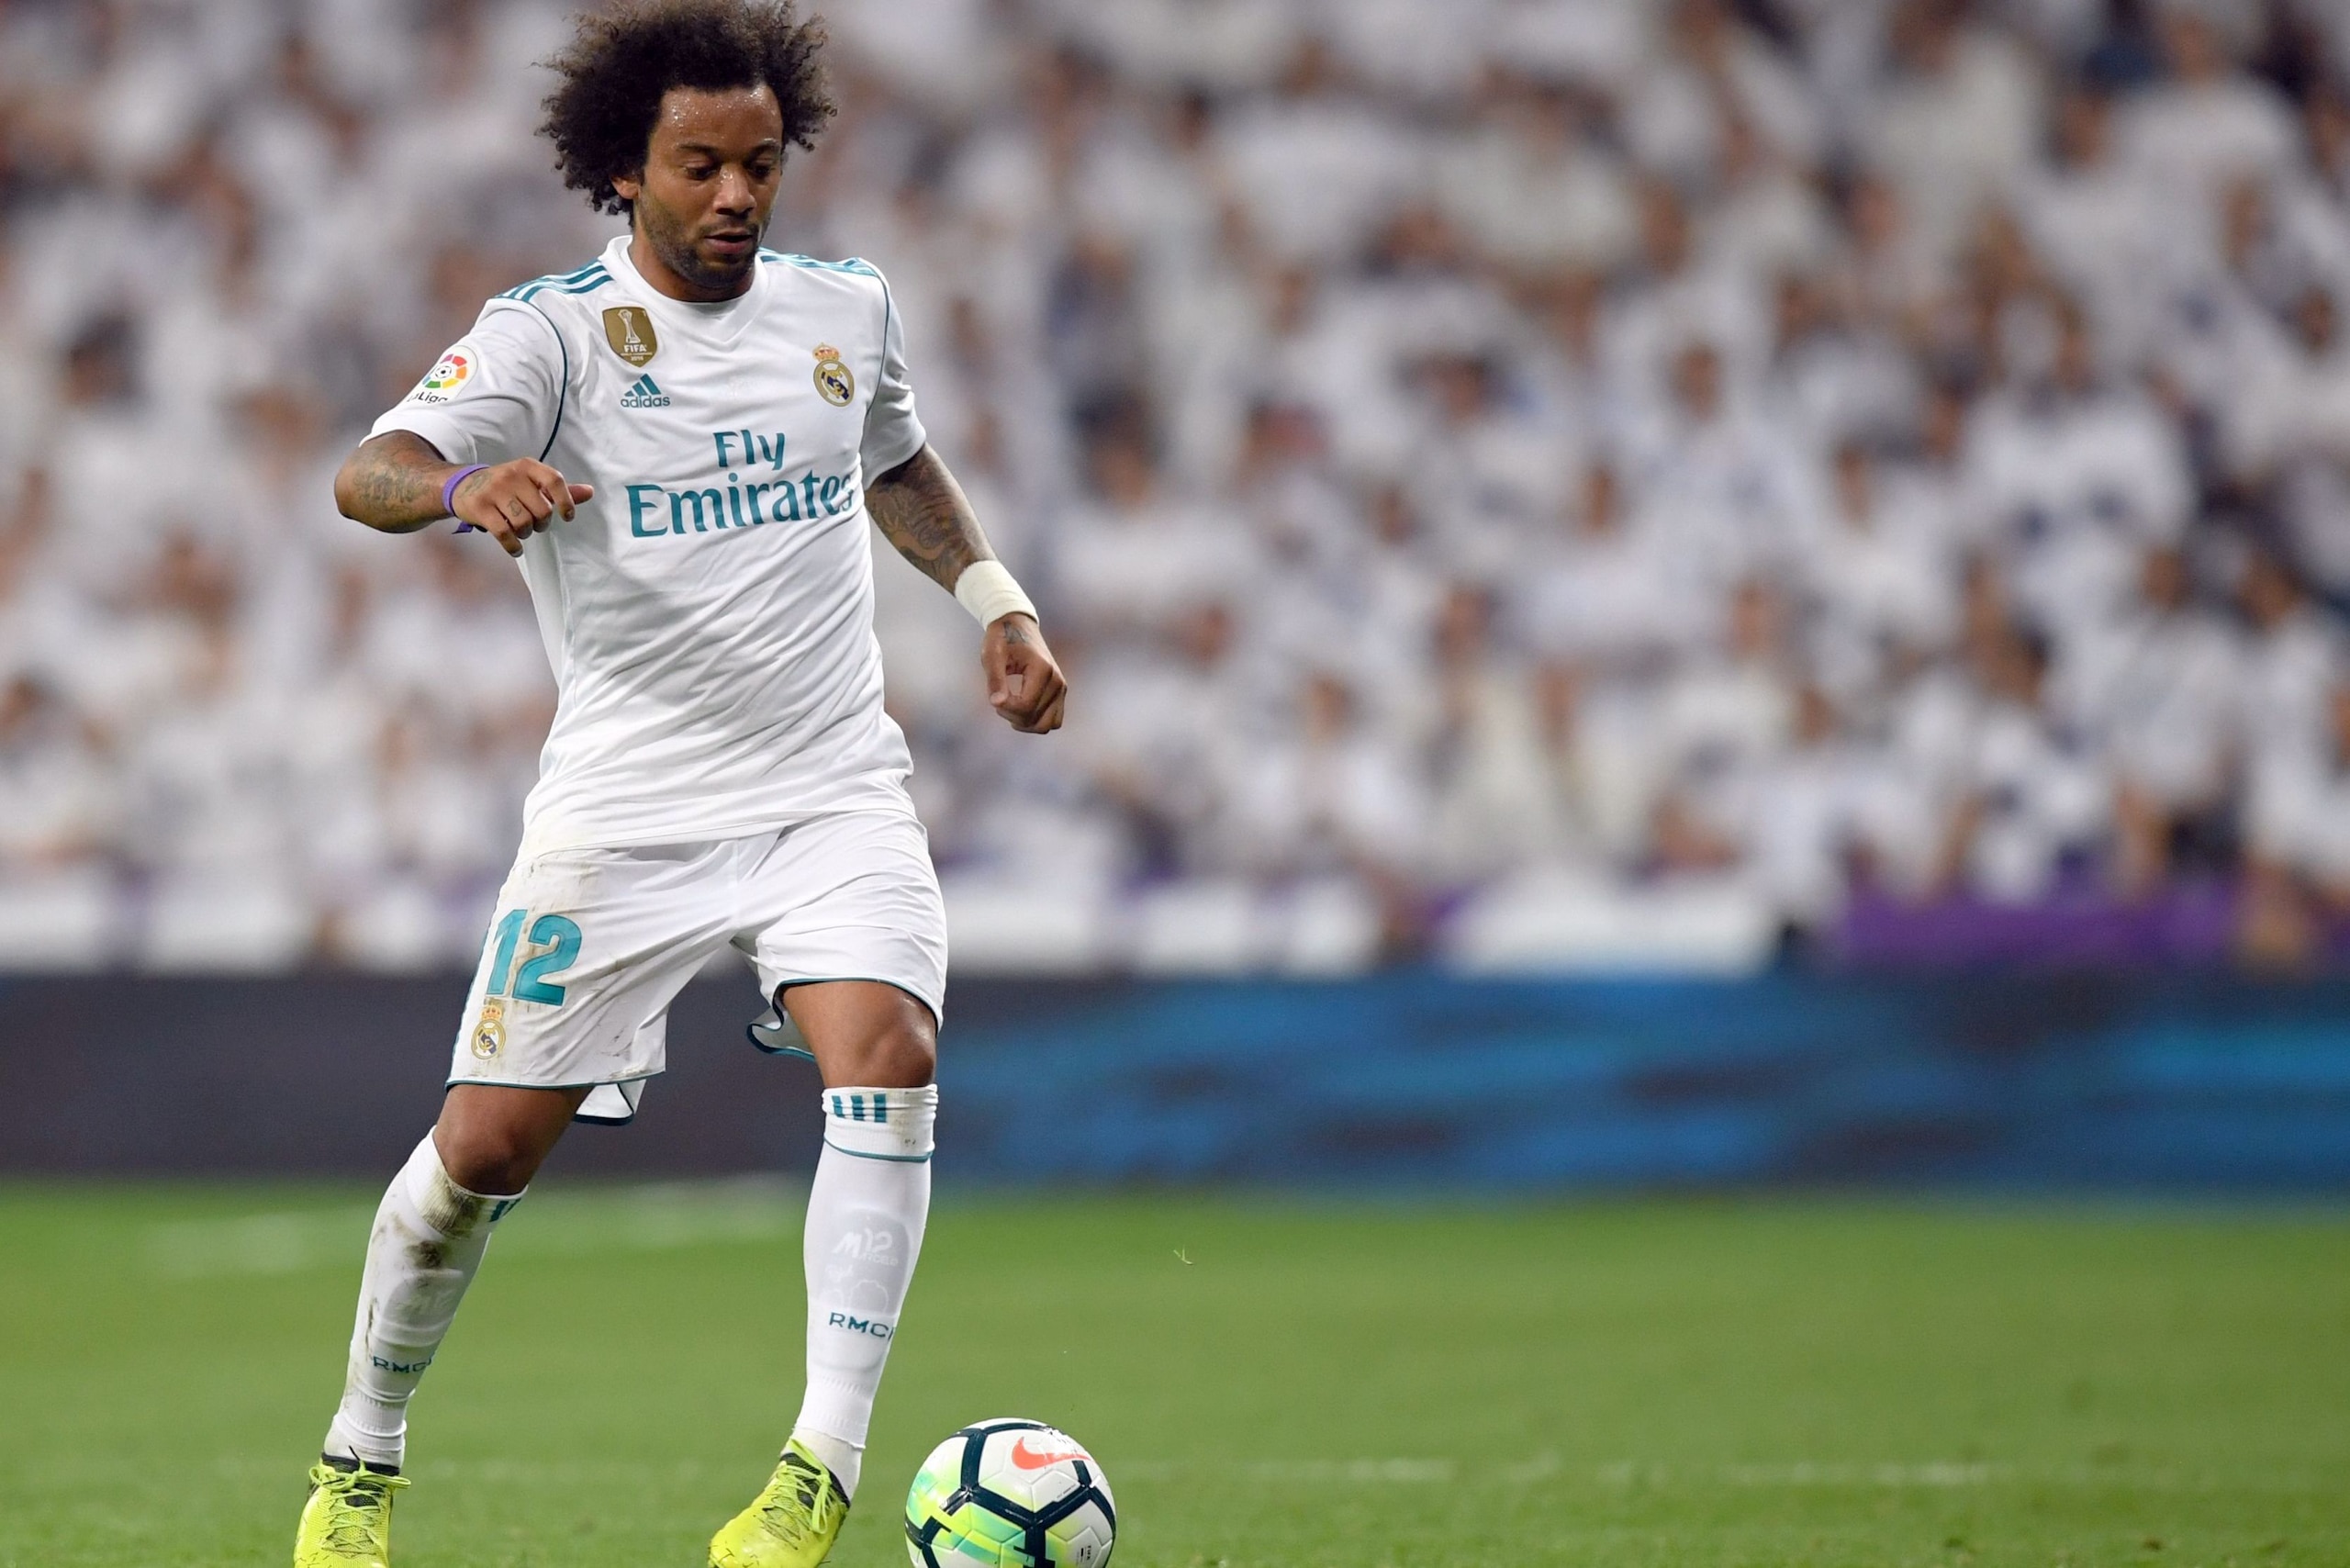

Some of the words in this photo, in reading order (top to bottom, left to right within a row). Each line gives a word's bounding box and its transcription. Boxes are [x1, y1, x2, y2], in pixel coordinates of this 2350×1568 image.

[623, 344, 647, 353] FIFA
[621, 396, 670, 408] adidas
[713, 430, 785, 470] Fly
[625, 469, 854, 538] Emirates
[486, 909, 583, 1006] 12
[829, 1312, 894, 1341] RMC
[374, 1356, 431, 1373] RMC
